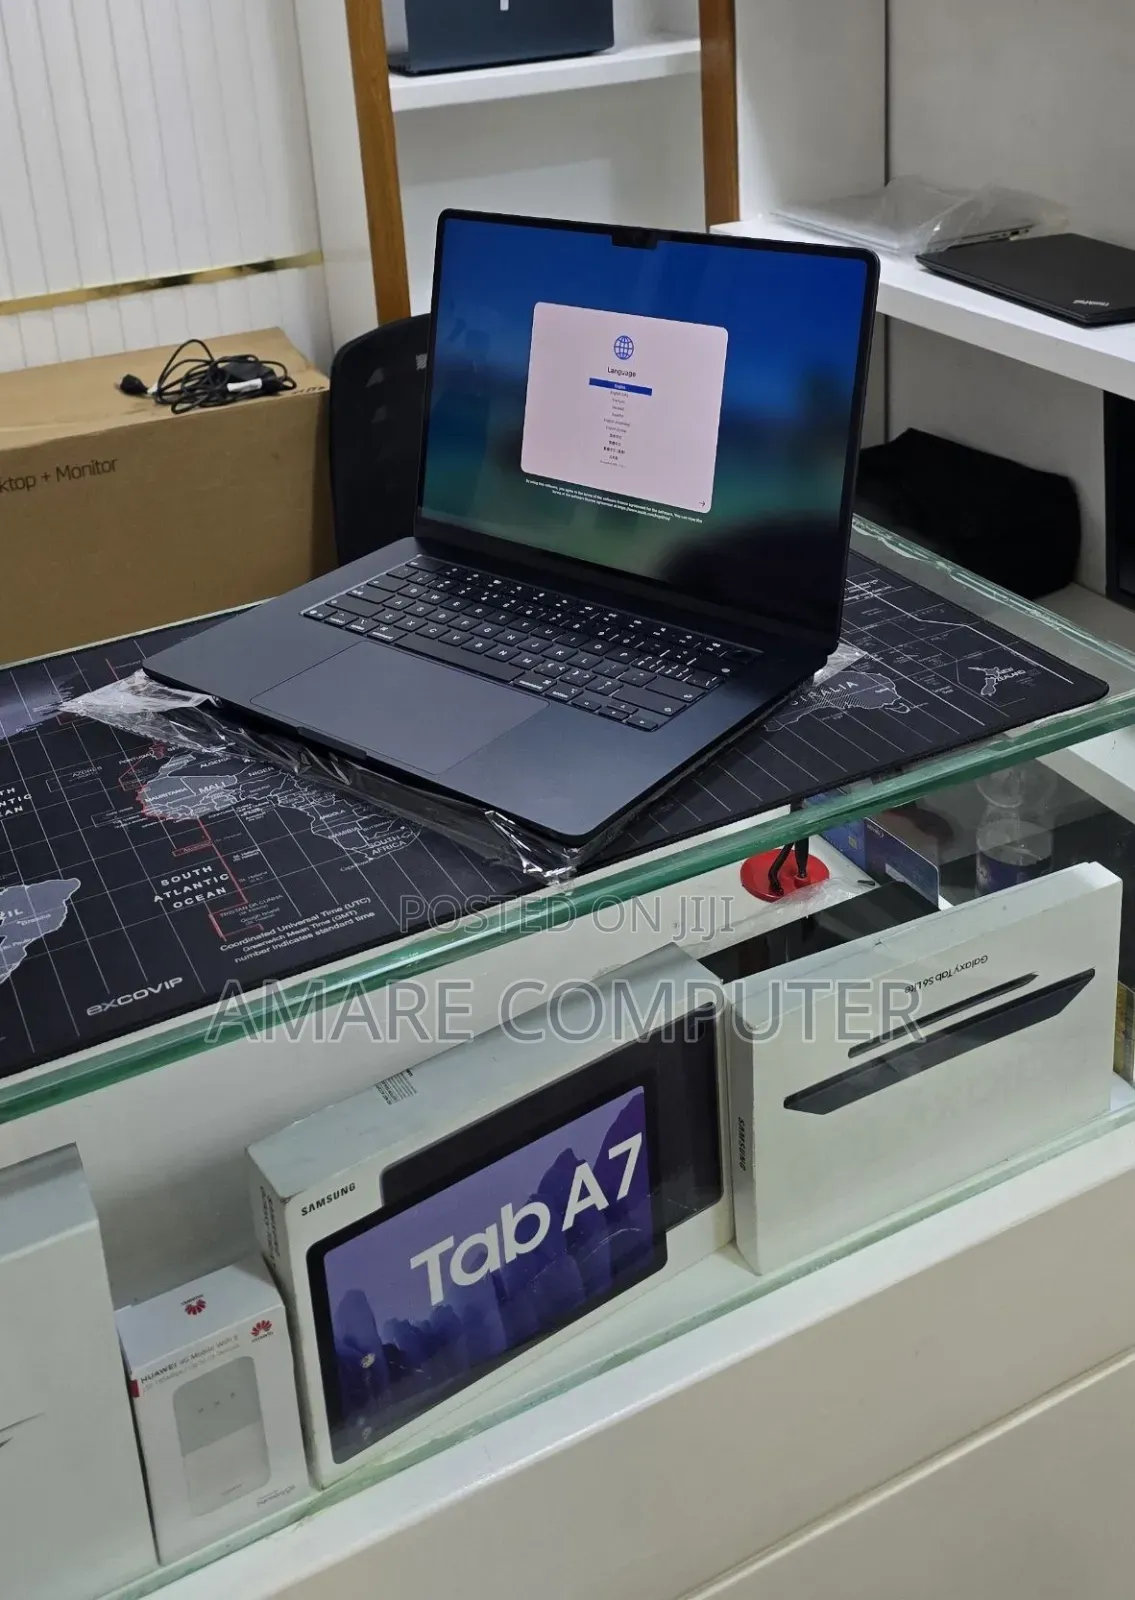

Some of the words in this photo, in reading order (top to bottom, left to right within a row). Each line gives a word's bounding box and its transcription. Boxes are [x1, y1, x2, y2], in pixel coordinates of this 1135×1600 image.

[607, 366, 637, 378] Language
[56, 458, 118, 483] Monitor
[198, 781, 226, 794] MALI
[372, 840, 407, 855] AFRICA
[160, 865, 213, 887] SOUTH
[154, 873, 229, 903] ATLANTIC
[172, 887, 227, 909] OCEAN
[220, 928, 276, 951] Coordinated
[276, 913, 320, 933] Universal
[320, 906, 343, 917] Time
[344, 897, 372, 910] (UTC)
[242, 935, 286, 952] Greenwich
[286, 927, 310, 938] Mean
[309, 919, 331, 929] Time
[331, 910, 358, 923] (GMT)
[234, 947, 271, 964] number
[315, 918, 355, 936] standard
[355, 912, 375, 922] time
[935, 968, 953, 981] Tab
[953, 954, 989, 975] Galaxy
[738, 1116, 746, 1172] SAMSUNG
[301, 1182, 356, 1217] SAMSUNG
[410, 1200, 551, 1307] Tab
[140, 1362, 178, 1384] HUAWEI
